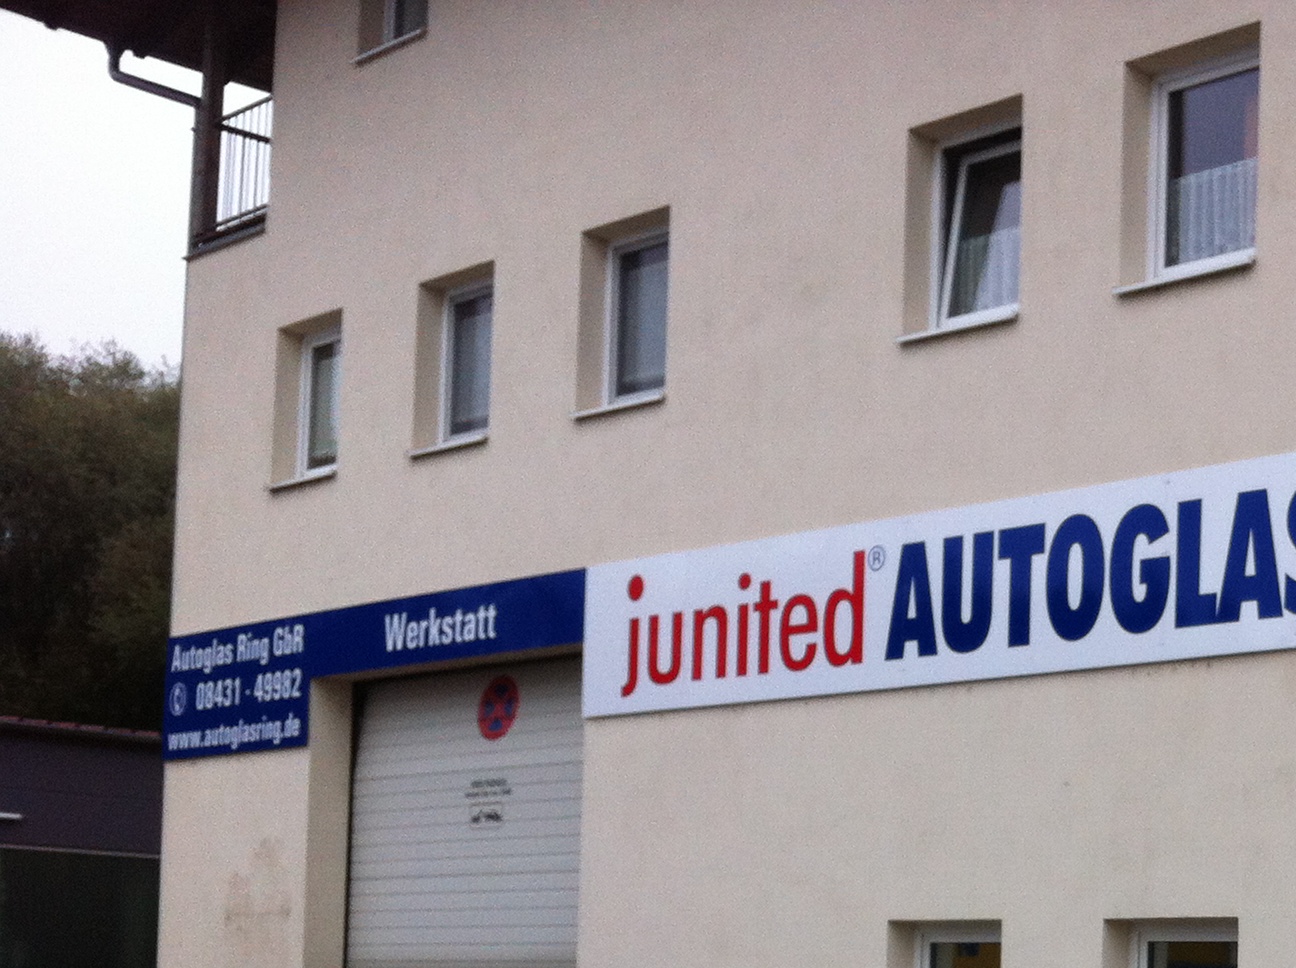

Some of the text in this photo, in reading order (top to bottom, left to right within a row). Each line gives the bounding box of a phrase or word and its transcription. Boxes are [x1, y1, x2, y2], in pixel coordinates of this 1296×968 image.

[384, 604, 497, 652] Werkstatt
[621, 550, 866, 698] junited
[171, 624, 305, 674] Autoglas Ring GbR
[195, 677, 241, 710] 08431
[254, 668, 303, 703] 49982
[167, 712, 301, 751] www.autoglasring.de
